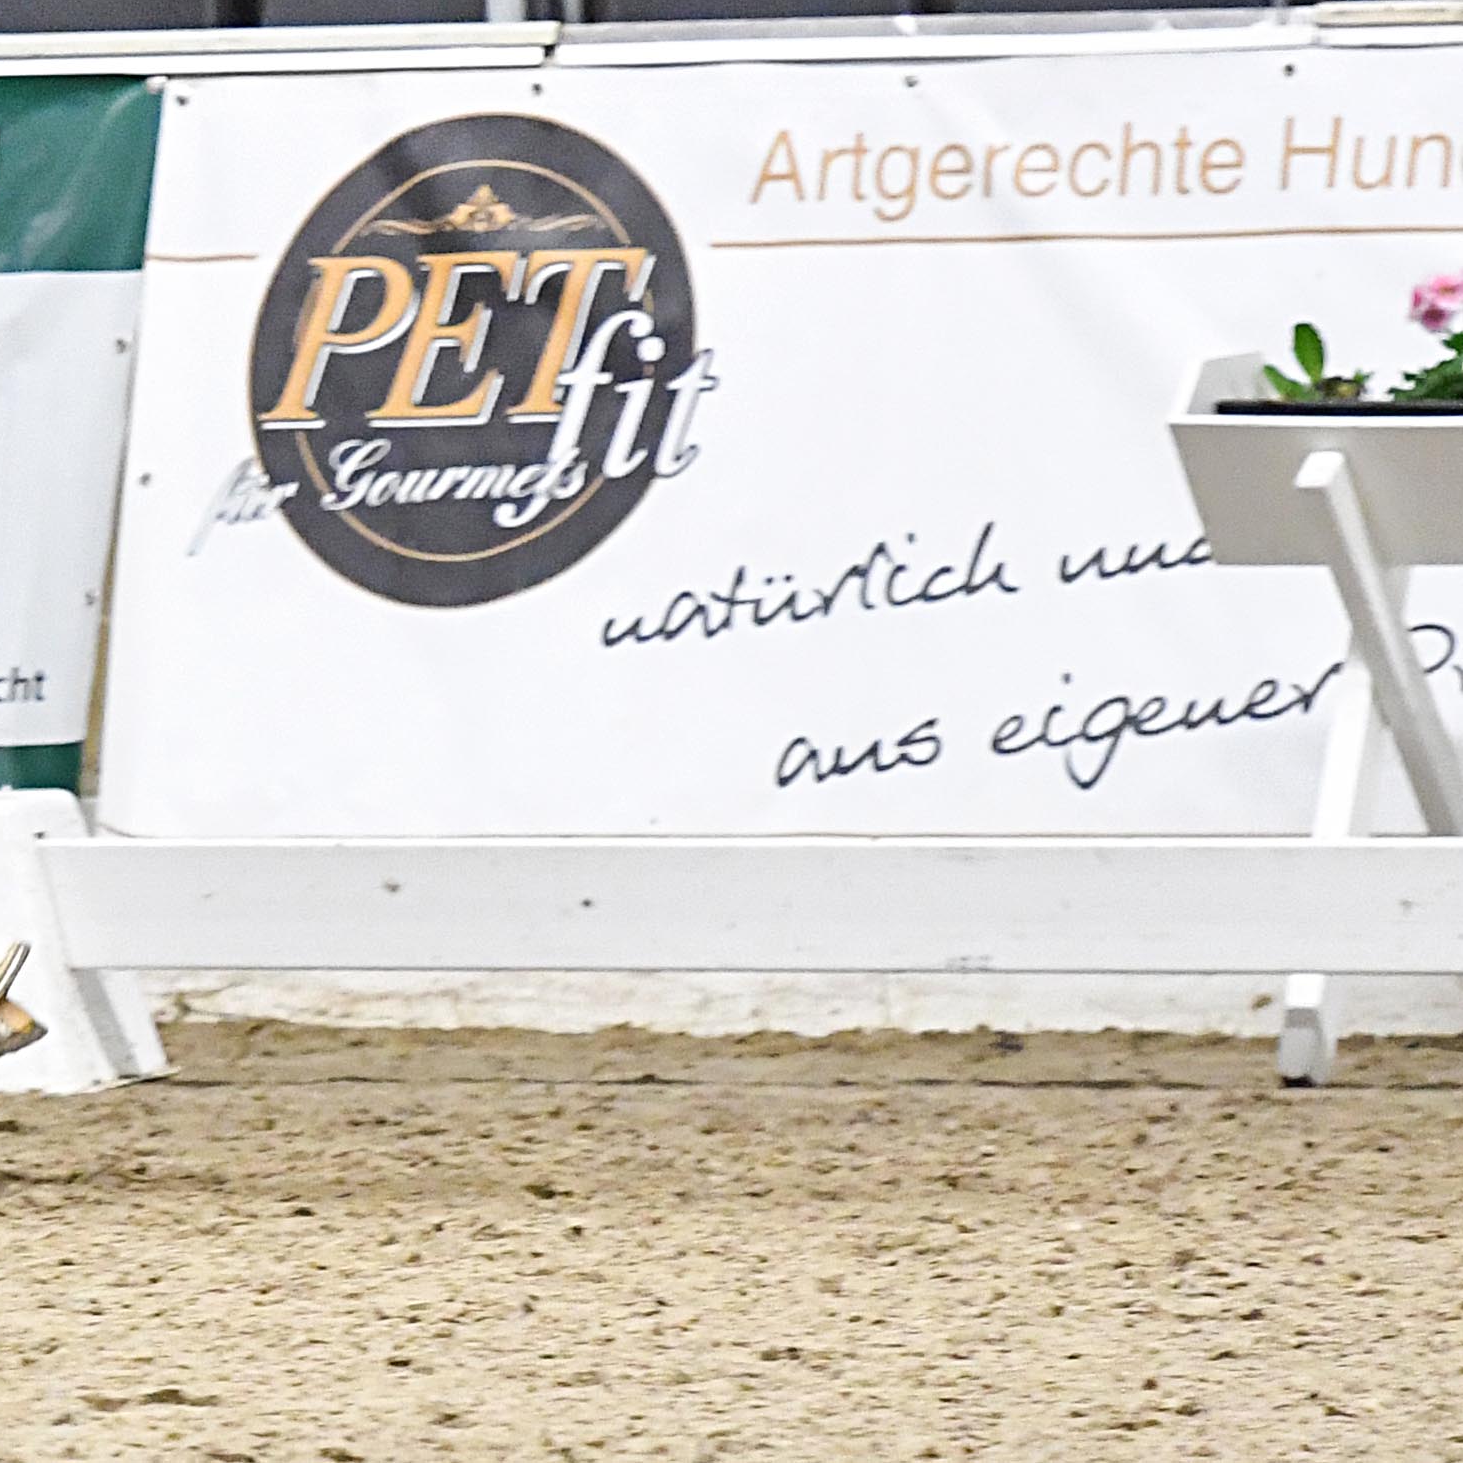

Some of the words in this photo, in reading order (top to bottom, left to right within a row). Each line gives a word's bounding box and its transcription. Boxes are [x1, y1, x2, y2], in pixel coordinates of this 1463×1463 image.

[749, 126, 1245, 222] Artgerechte
[1279, 116, 1463, 191] Hun
[258, 247, 656, 430] PET
[490, 310, 718, 529] fit
[600, 522, 1018, 648] natürlich
[775, 716, 942, 789] aus
[991, 672, 1347, 790] eigener
